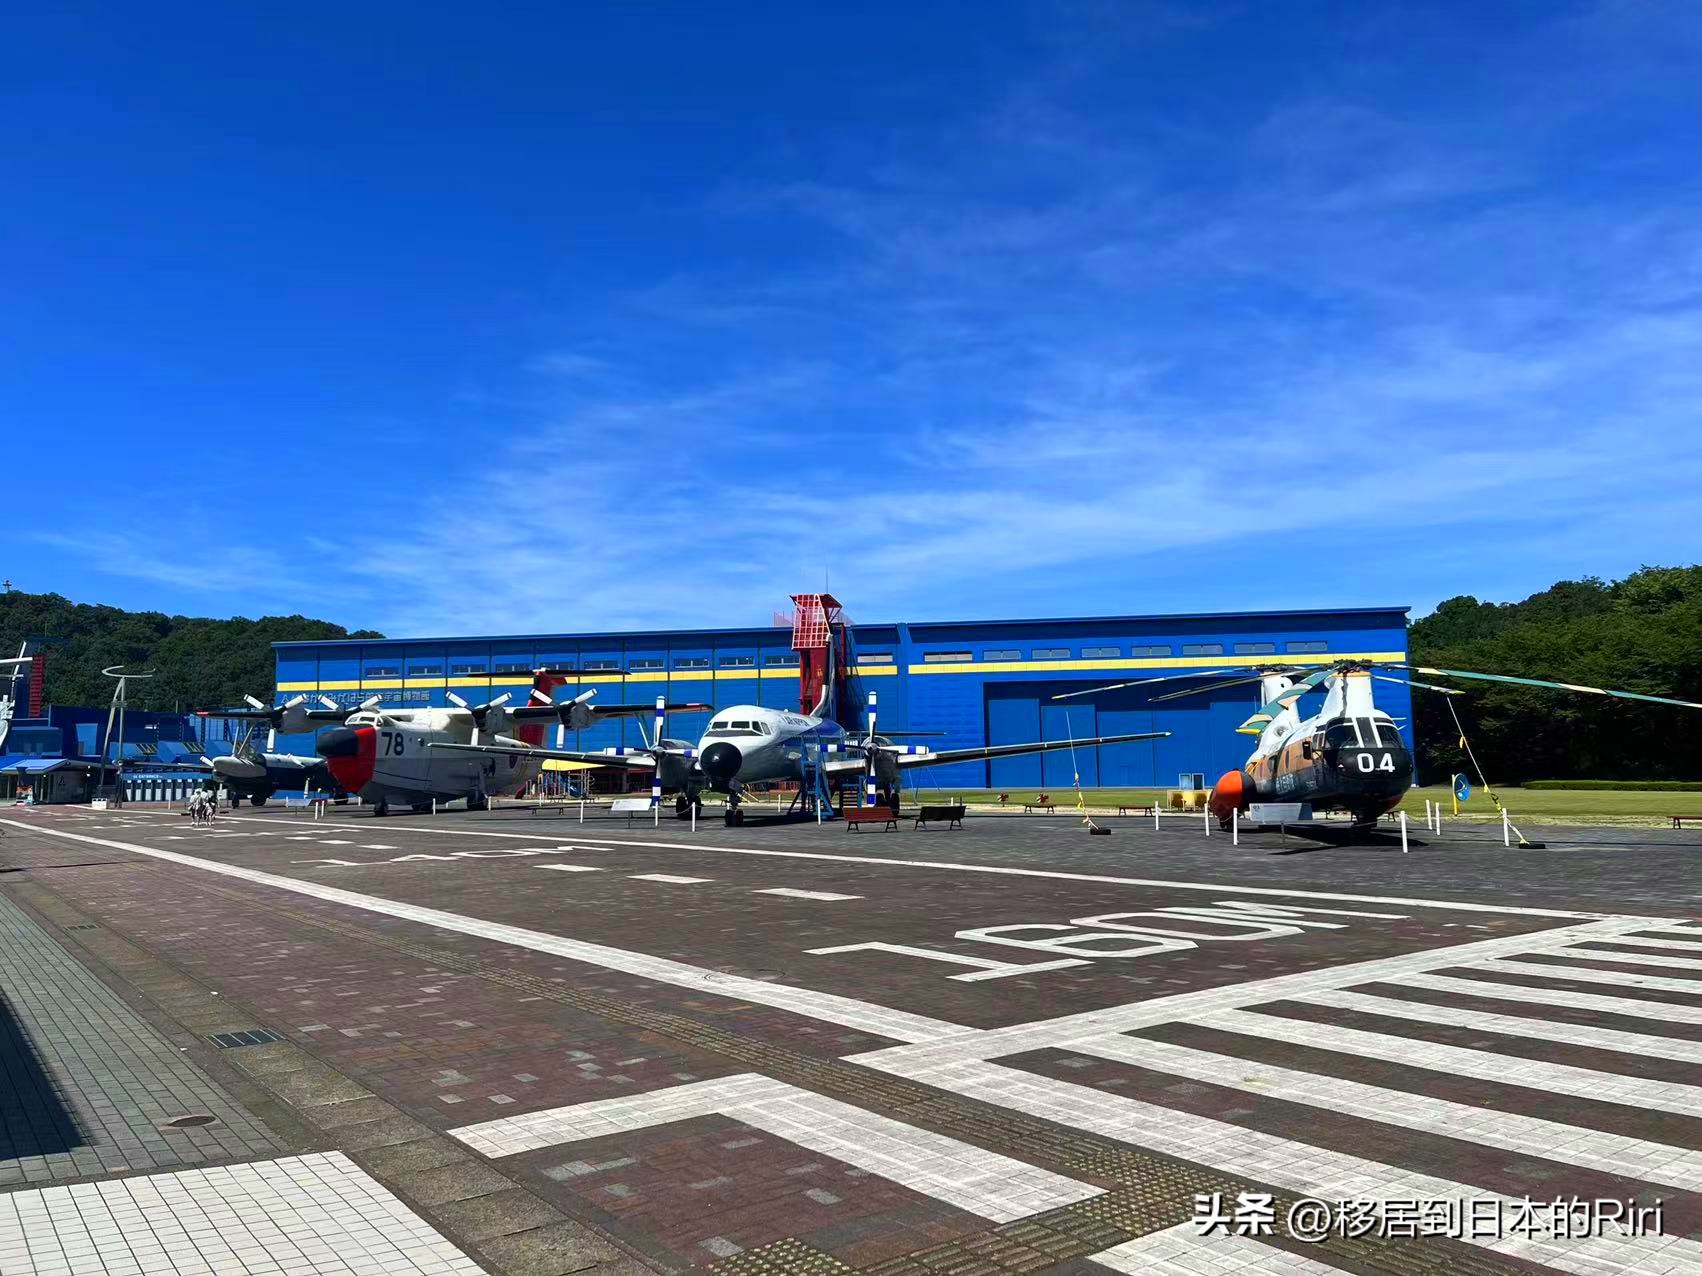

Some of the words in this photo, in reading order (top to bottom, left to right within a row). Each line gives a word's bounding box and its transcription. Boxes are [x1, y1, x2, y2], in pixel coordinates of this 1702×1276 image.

[381, 731, 405, 756] 78
[1357, 753, 1395, 772] 04
[802, 901, 1411, 983] 160M
